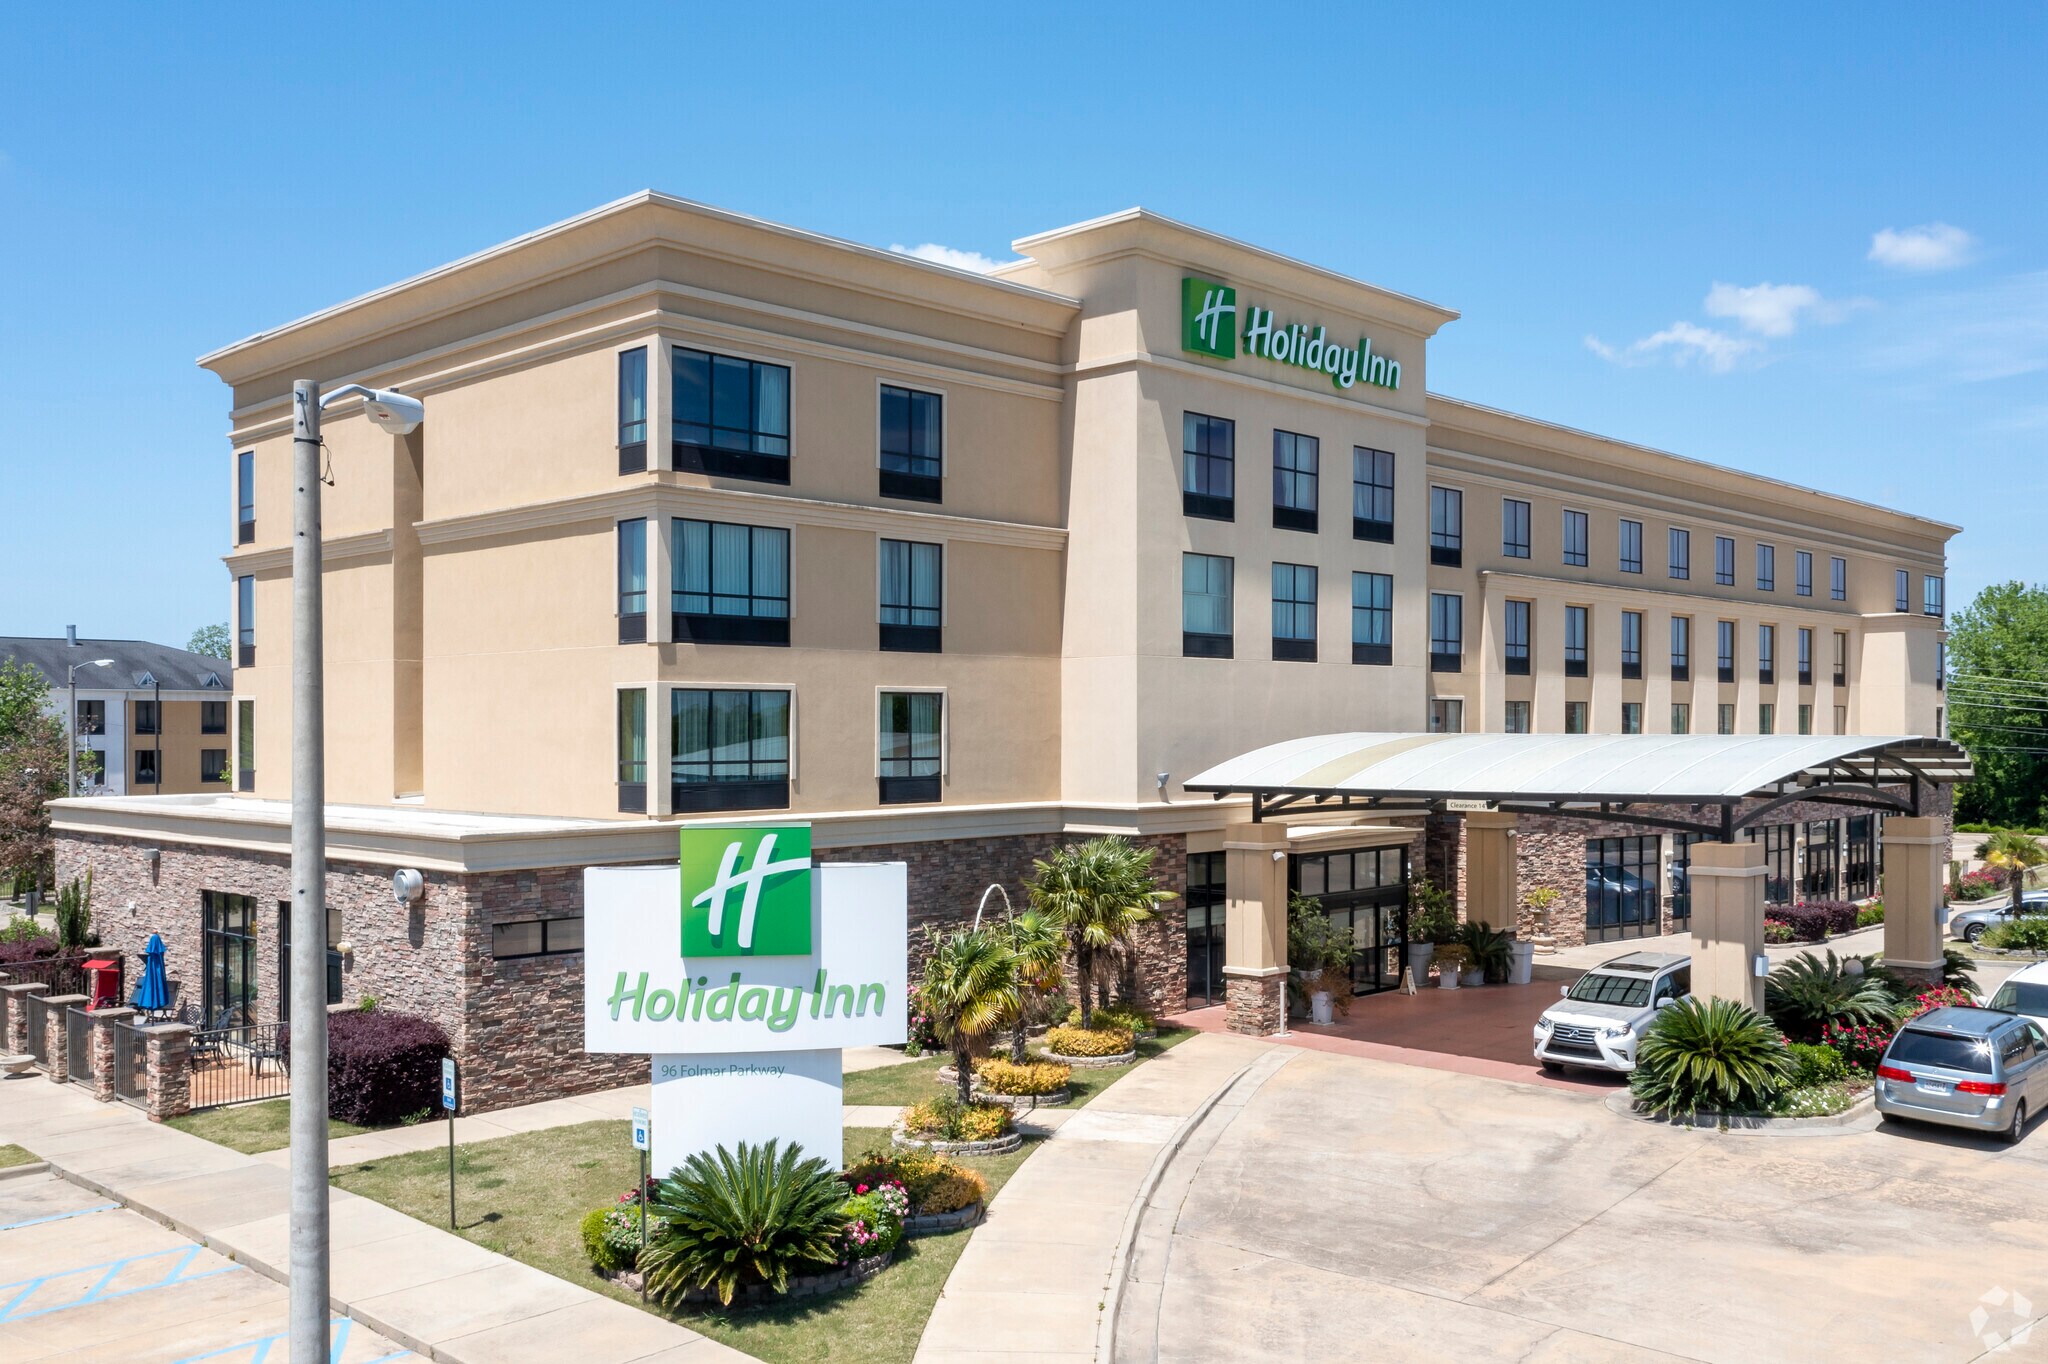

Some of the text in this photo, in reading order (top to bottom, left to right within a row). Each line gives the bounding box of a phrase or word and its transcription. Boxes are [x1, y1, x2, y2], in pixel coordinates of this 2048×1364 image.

[1244, 306, 1402, 390] Holiday Inn
[607, 968, 886, 1032] Holiday Inn
[661, 1063, 785, 1079] 96 Folmar Parkway
